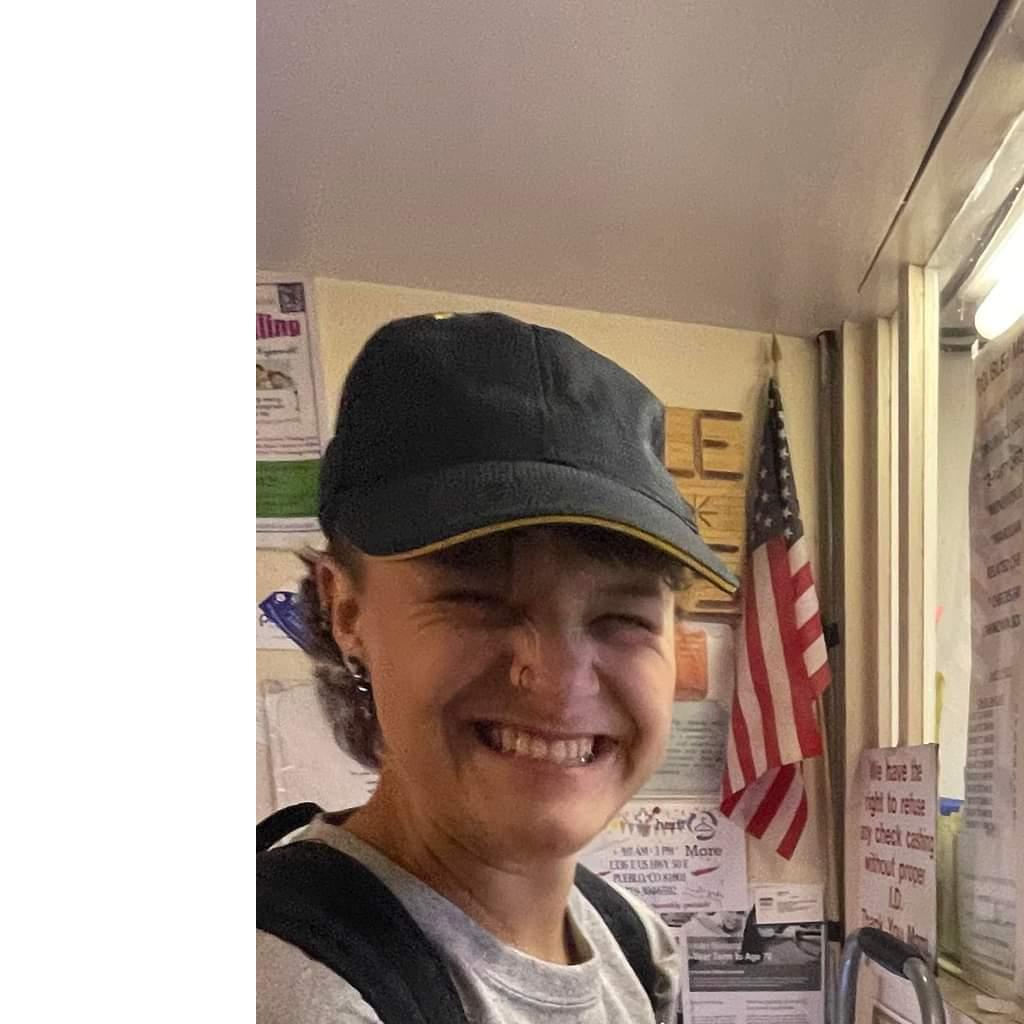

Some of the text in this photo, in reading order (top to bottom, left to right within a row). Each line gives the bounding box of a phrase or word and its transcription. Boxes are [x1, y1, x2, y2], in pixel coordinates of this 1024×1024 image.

[885, 756, 907, 781] have
[911, 757, 922, 781] the
[865, 791, 926, 818] right to refuse
[875, 822, 903, 846] check
[685, 845, 723, 857] More
[865, 852, 926, 885] without proper
